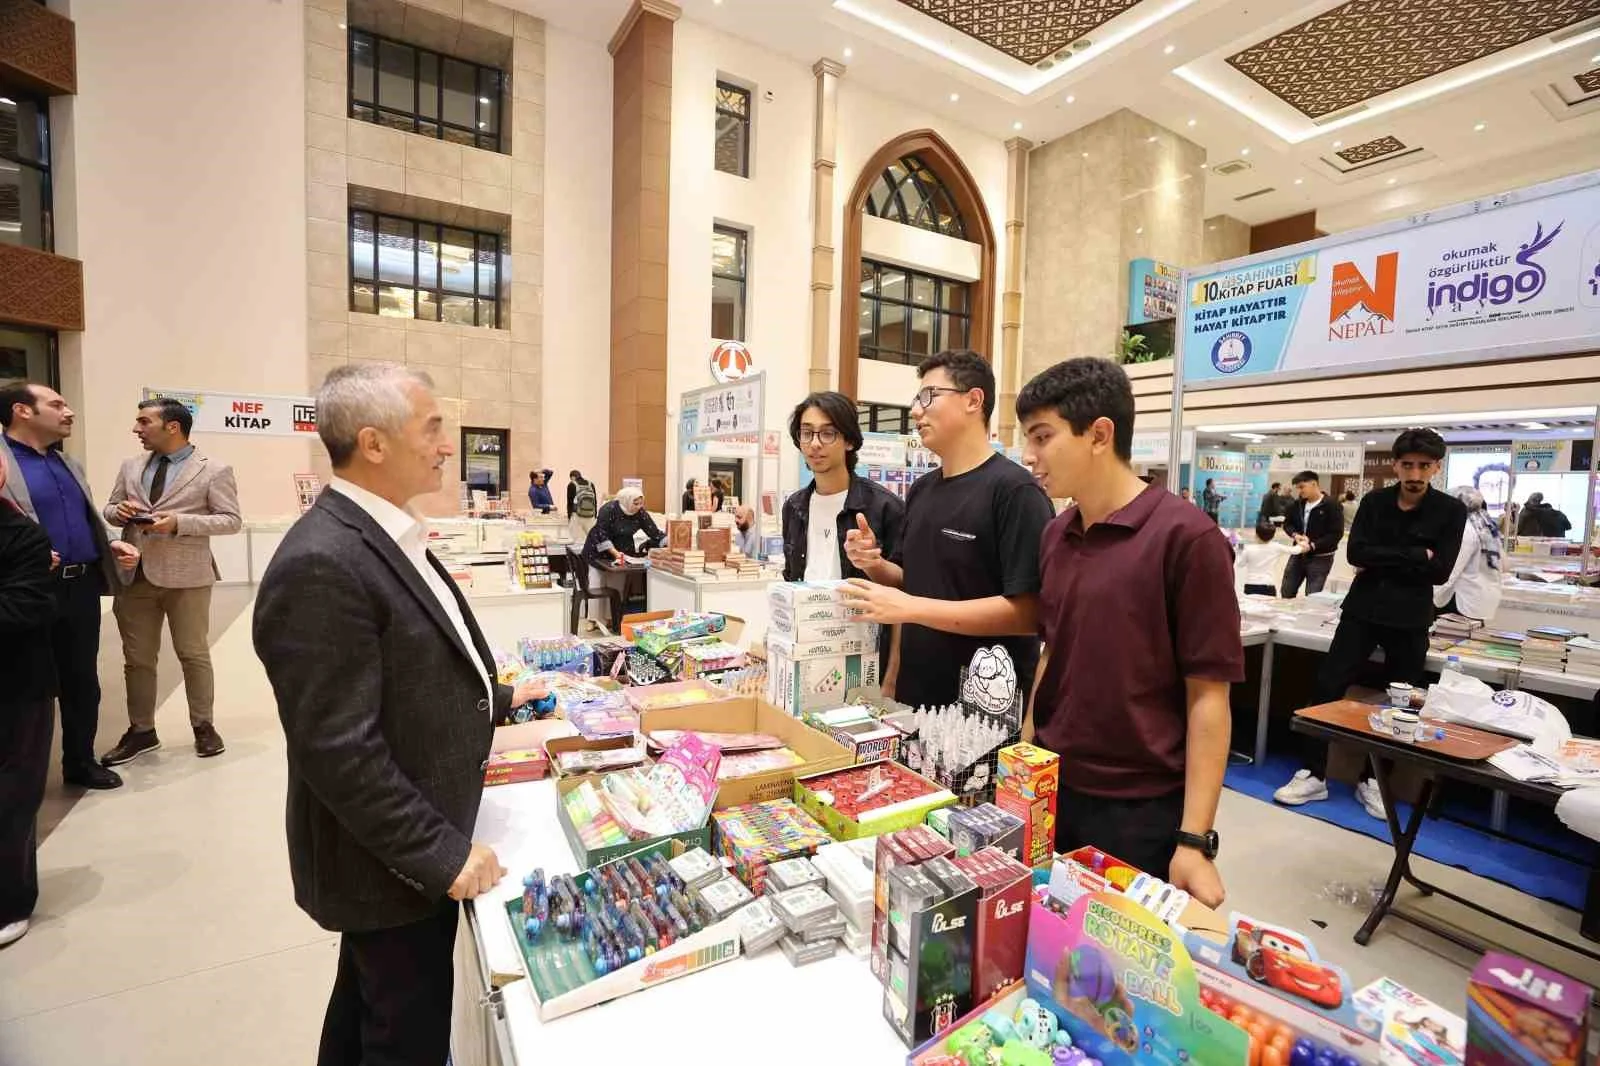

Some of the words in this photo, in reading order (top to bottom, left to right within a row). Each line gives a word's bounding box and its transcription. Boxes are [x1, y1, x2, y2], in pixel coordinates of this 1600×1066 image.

[1442, 242, 1498, 262] okumak
[1429, 255, 1511, 278] özgürlüktür
[1257, 274, 1298, 293] FUARI
[1428, 269, 1541, 307] indigo
[1195, 308, 1227, 321] KİTAP
[1229, 297, 1287, 315] HAYATTIR
[1194, 320, 1228, 334] HAYAT
[1231, 310, 1287, 328] KİTAPTIR
[1328, 320, 1394, 342] NEPAL
[232, 402, 264, 414] NEF
[224, 414, 271, 430] KİTAP
[859, 738, 889, 754] WORLD
[931, 912, 967, 934] PULSE
[1084, 912, 1176, 980] ROTATE
[1125, 968, 1183, 1016] BALL
